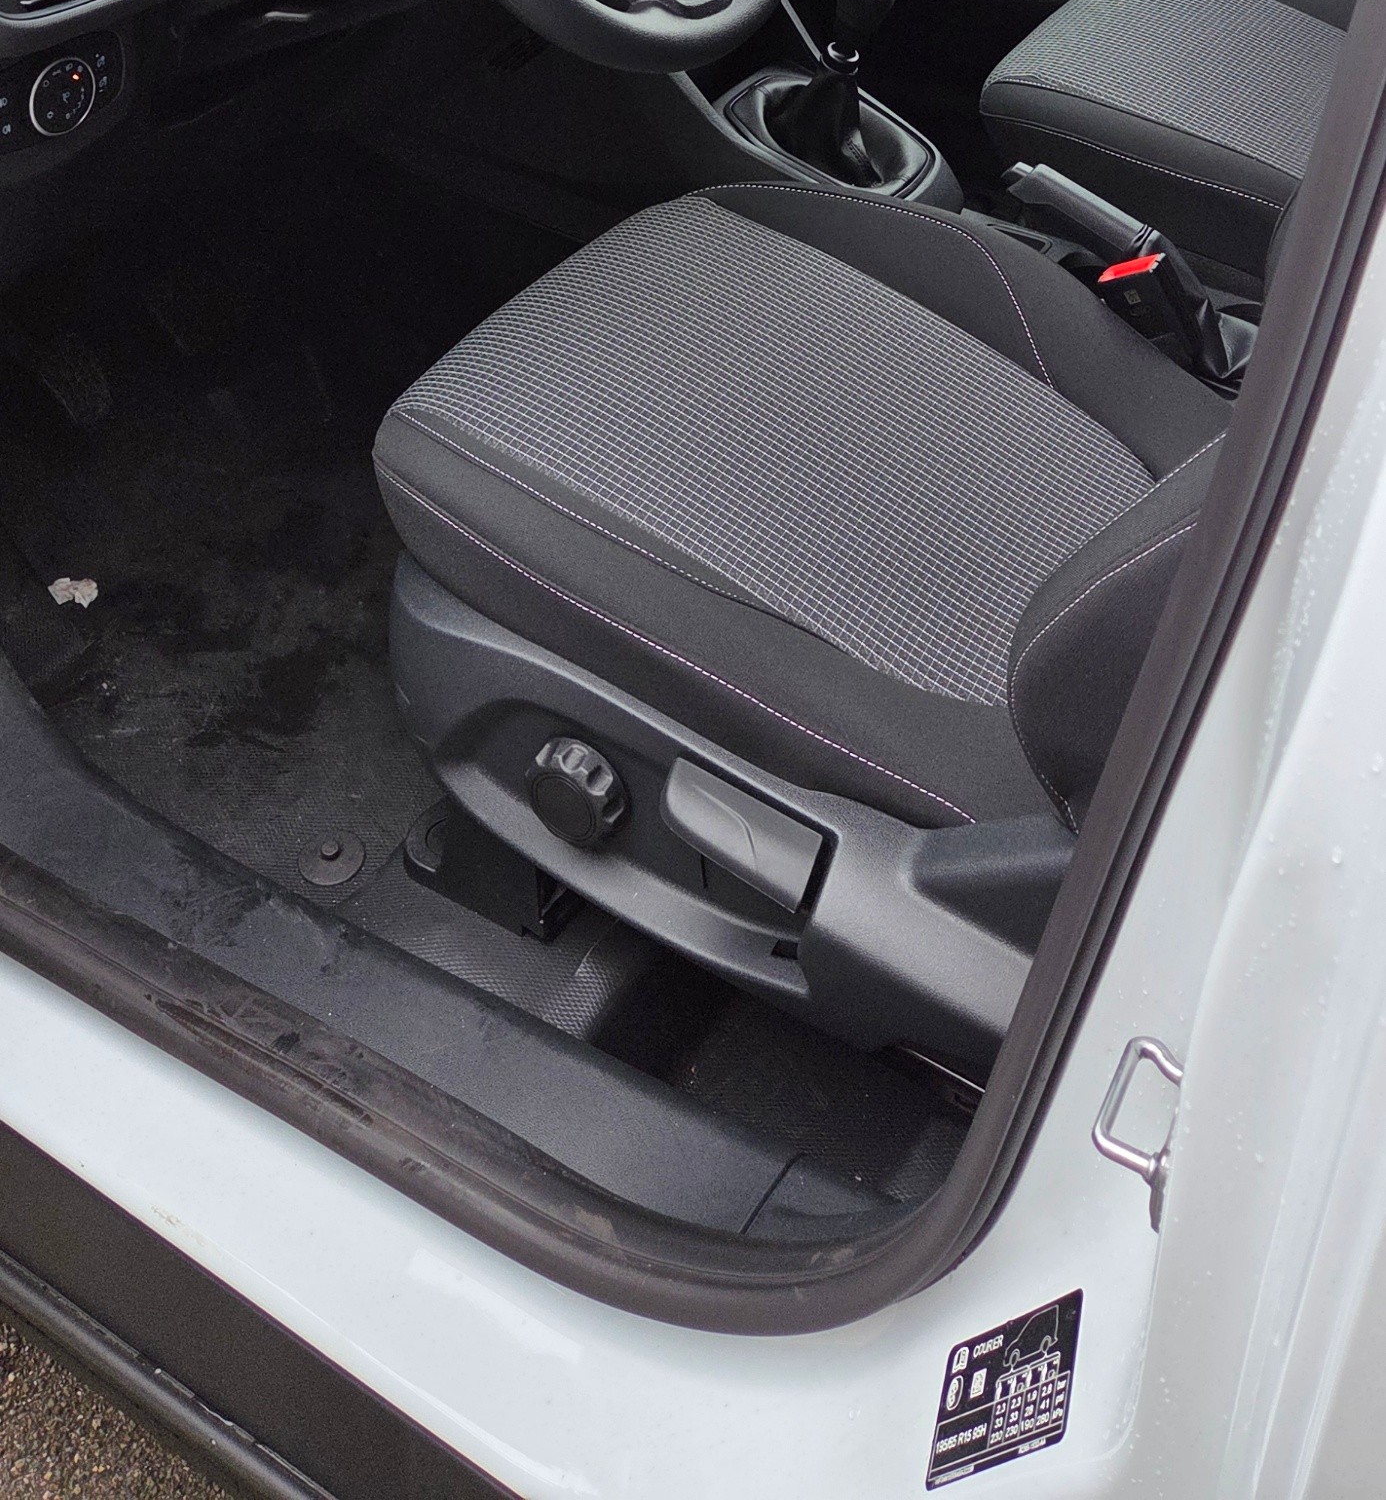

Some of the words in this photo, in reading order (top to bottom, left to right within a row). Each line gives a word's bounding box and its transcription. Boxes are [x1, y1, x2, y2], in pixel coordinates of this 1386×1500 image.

[972, 1334, 1004, 1359] COURIER
[1010, 1396, 1022, 1410] 2.3
[1027, 1389, 1038, 1403] 1.9
[994, 1417, 1004, 1429] 33
[1009, 1410, 1019, 1423] 33
[1039, 1398, 1050, 1410] 41
[1005, 1424, 1019, 1438] 230
[1020, 1418, 1035, 1432] 190
